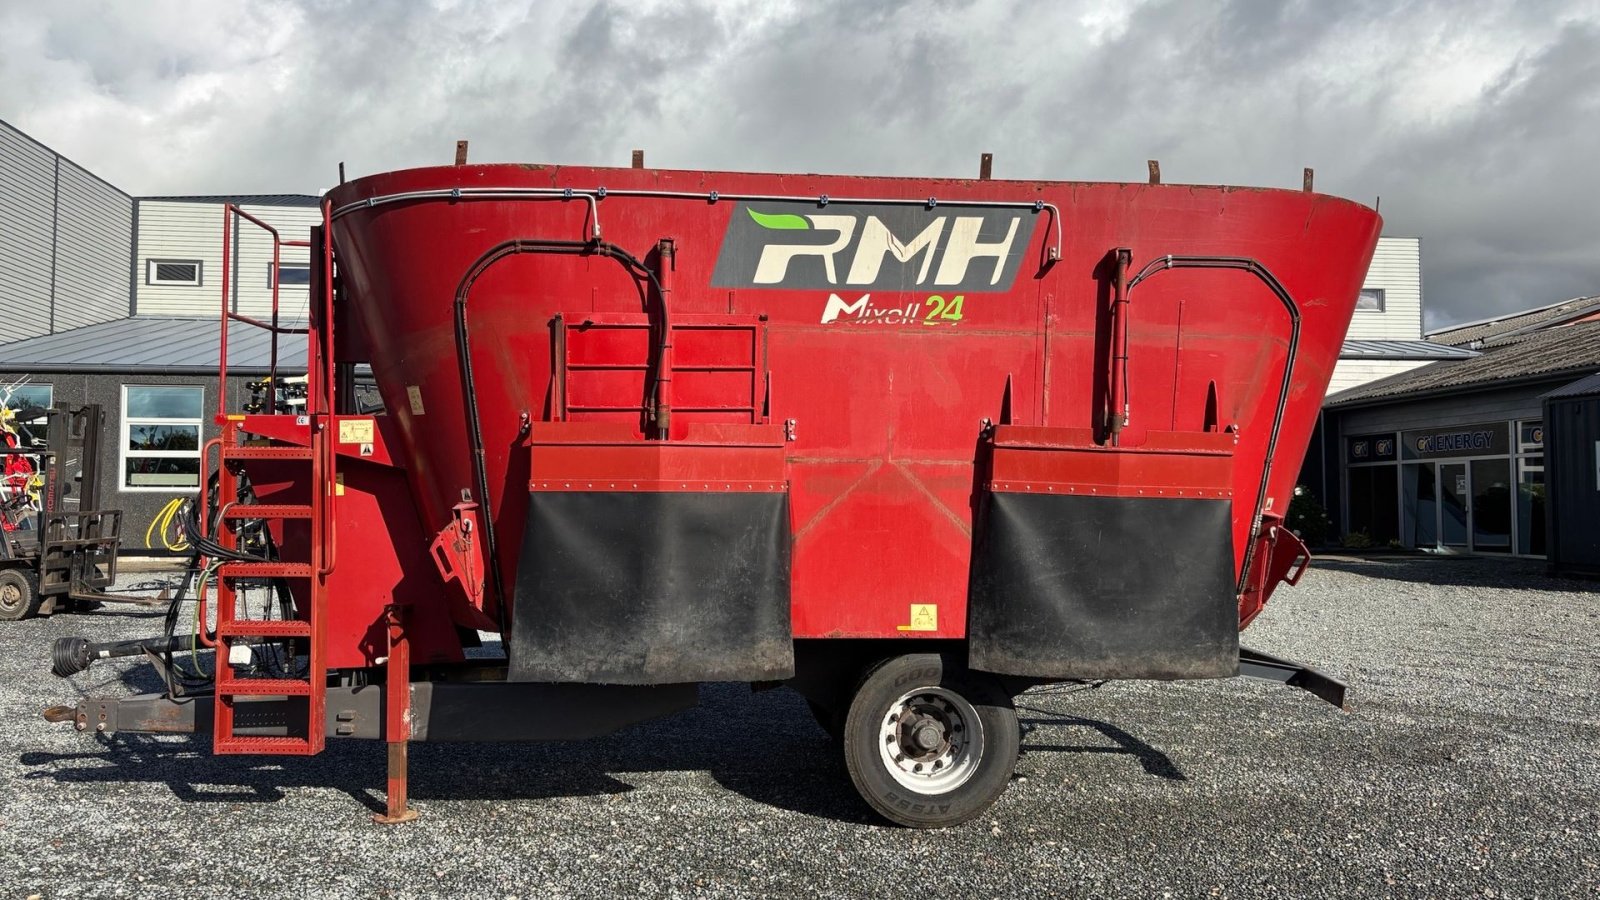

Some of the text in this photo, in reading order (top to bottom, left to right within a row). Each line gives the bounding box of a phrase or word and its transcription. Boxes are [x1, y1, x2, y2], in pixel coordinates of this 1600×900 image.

[747, 207, 1021, 286] RMH
[924, 295, 965, 326] 24
[1436, 431, 1493, 451] ENERGY
[1531, 428, 1543, 443] C
[47, 467, 56, 512] KOMATSU
